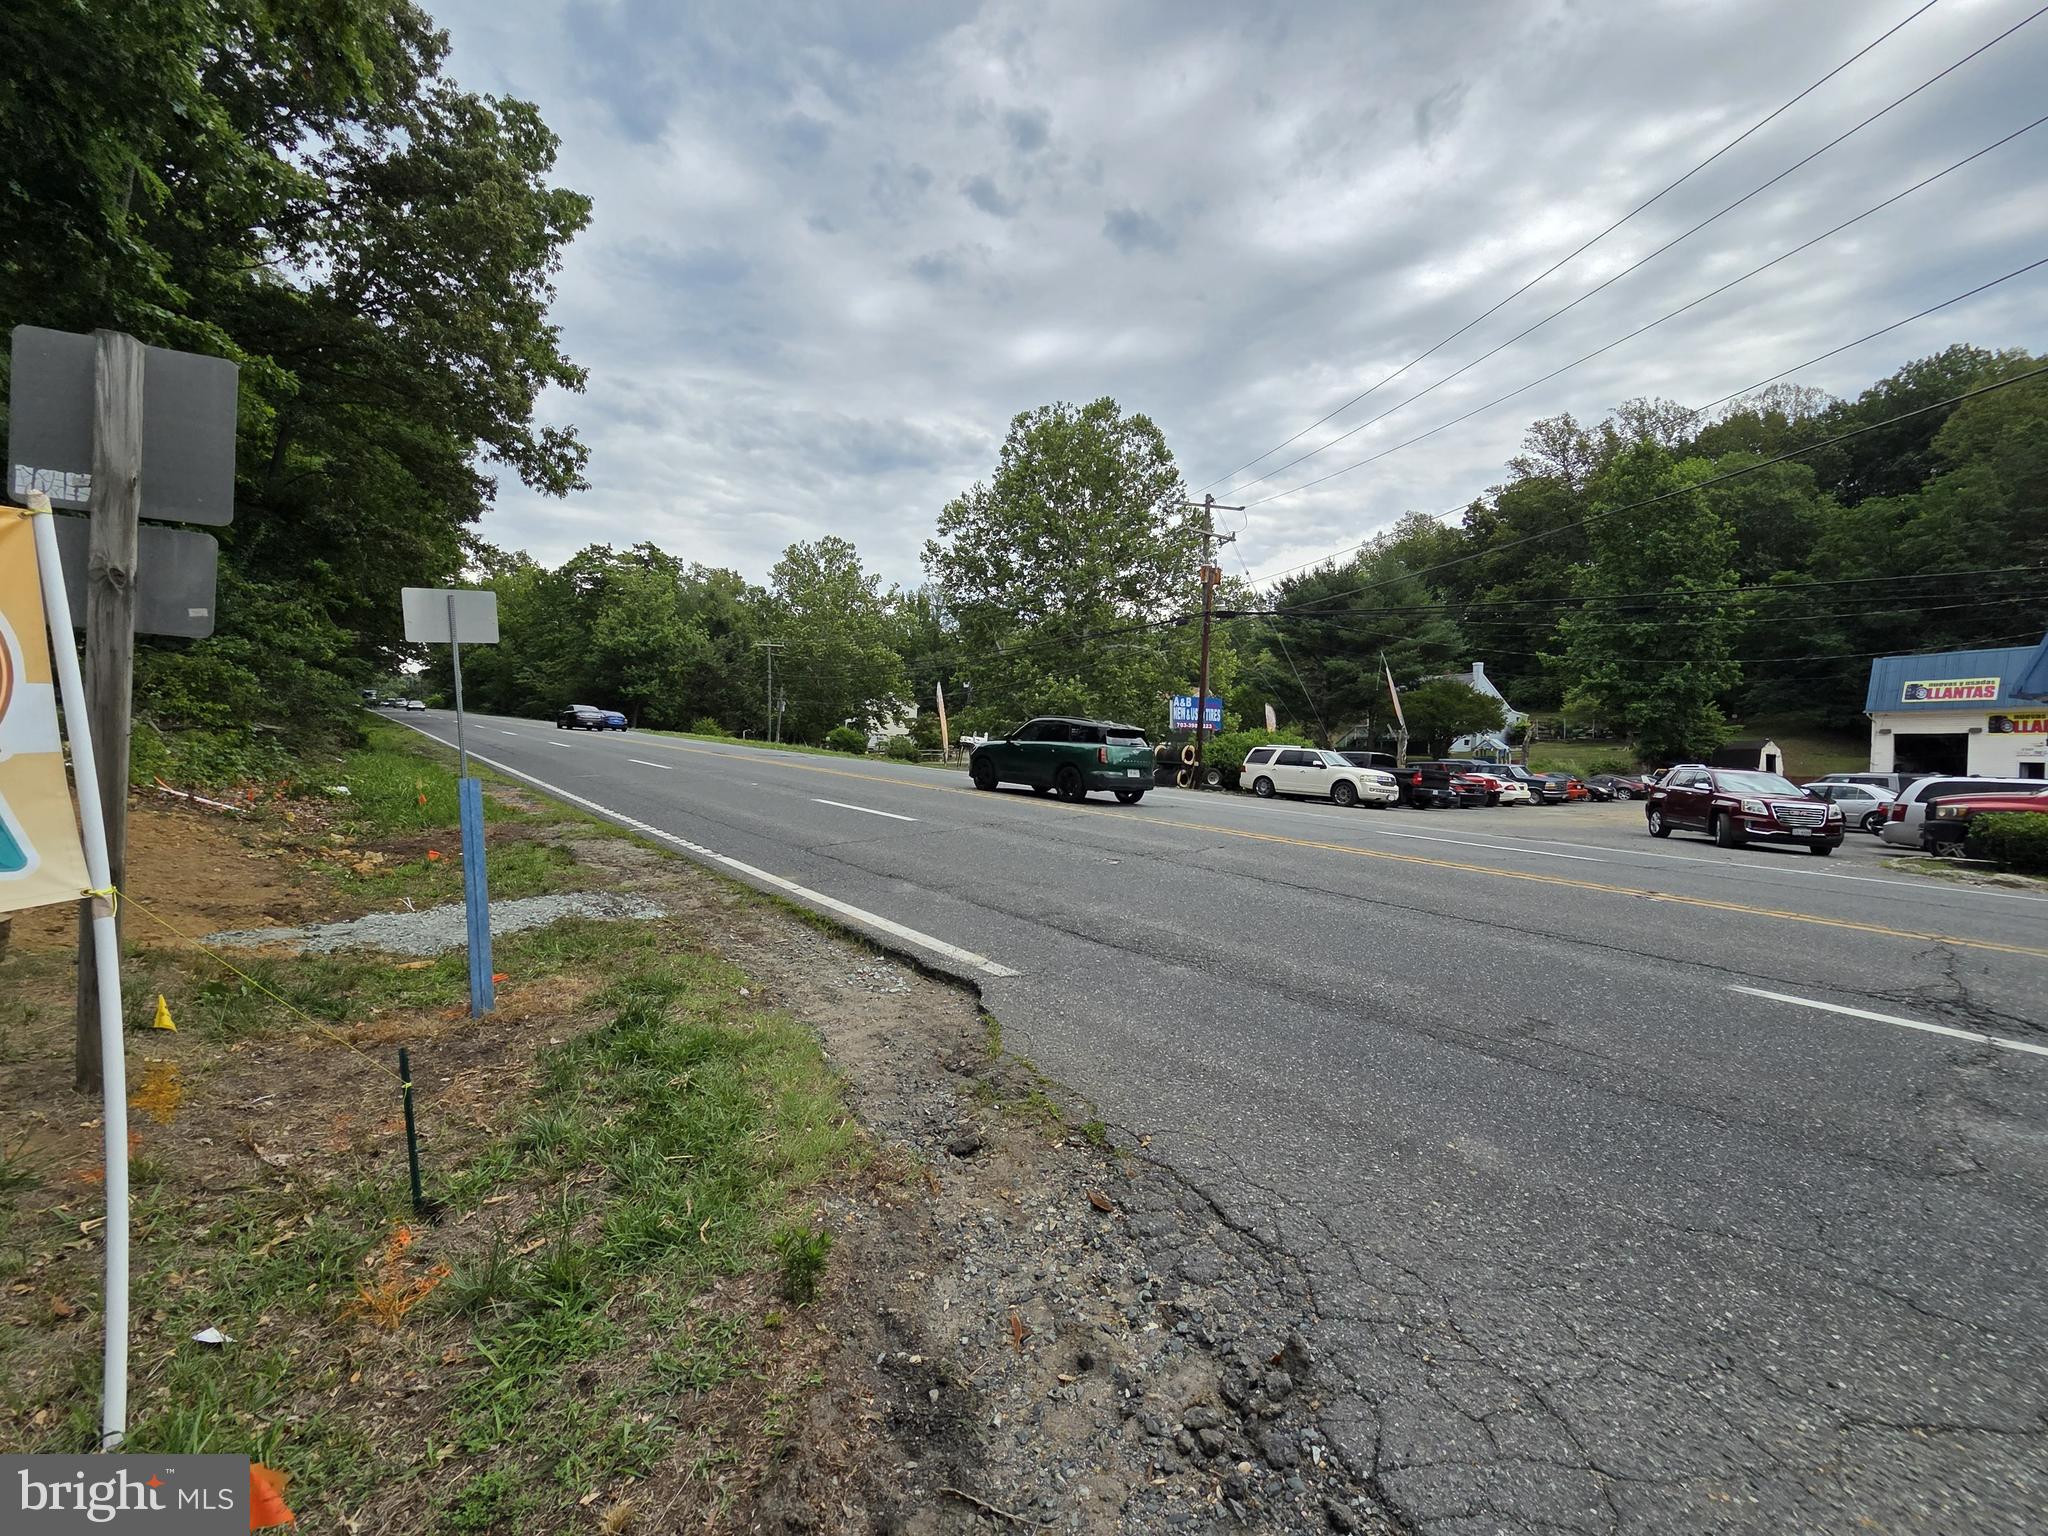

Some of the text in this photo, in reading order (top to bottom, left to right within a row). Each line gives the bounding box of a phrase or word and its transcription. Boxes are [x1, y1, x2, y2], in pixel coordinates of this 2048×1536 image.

[1926, 686, 1995, 699] LLANTAS
[1173, 707, 1186, 720] NEW
[1206, 708, 1221, 721] TIRES
